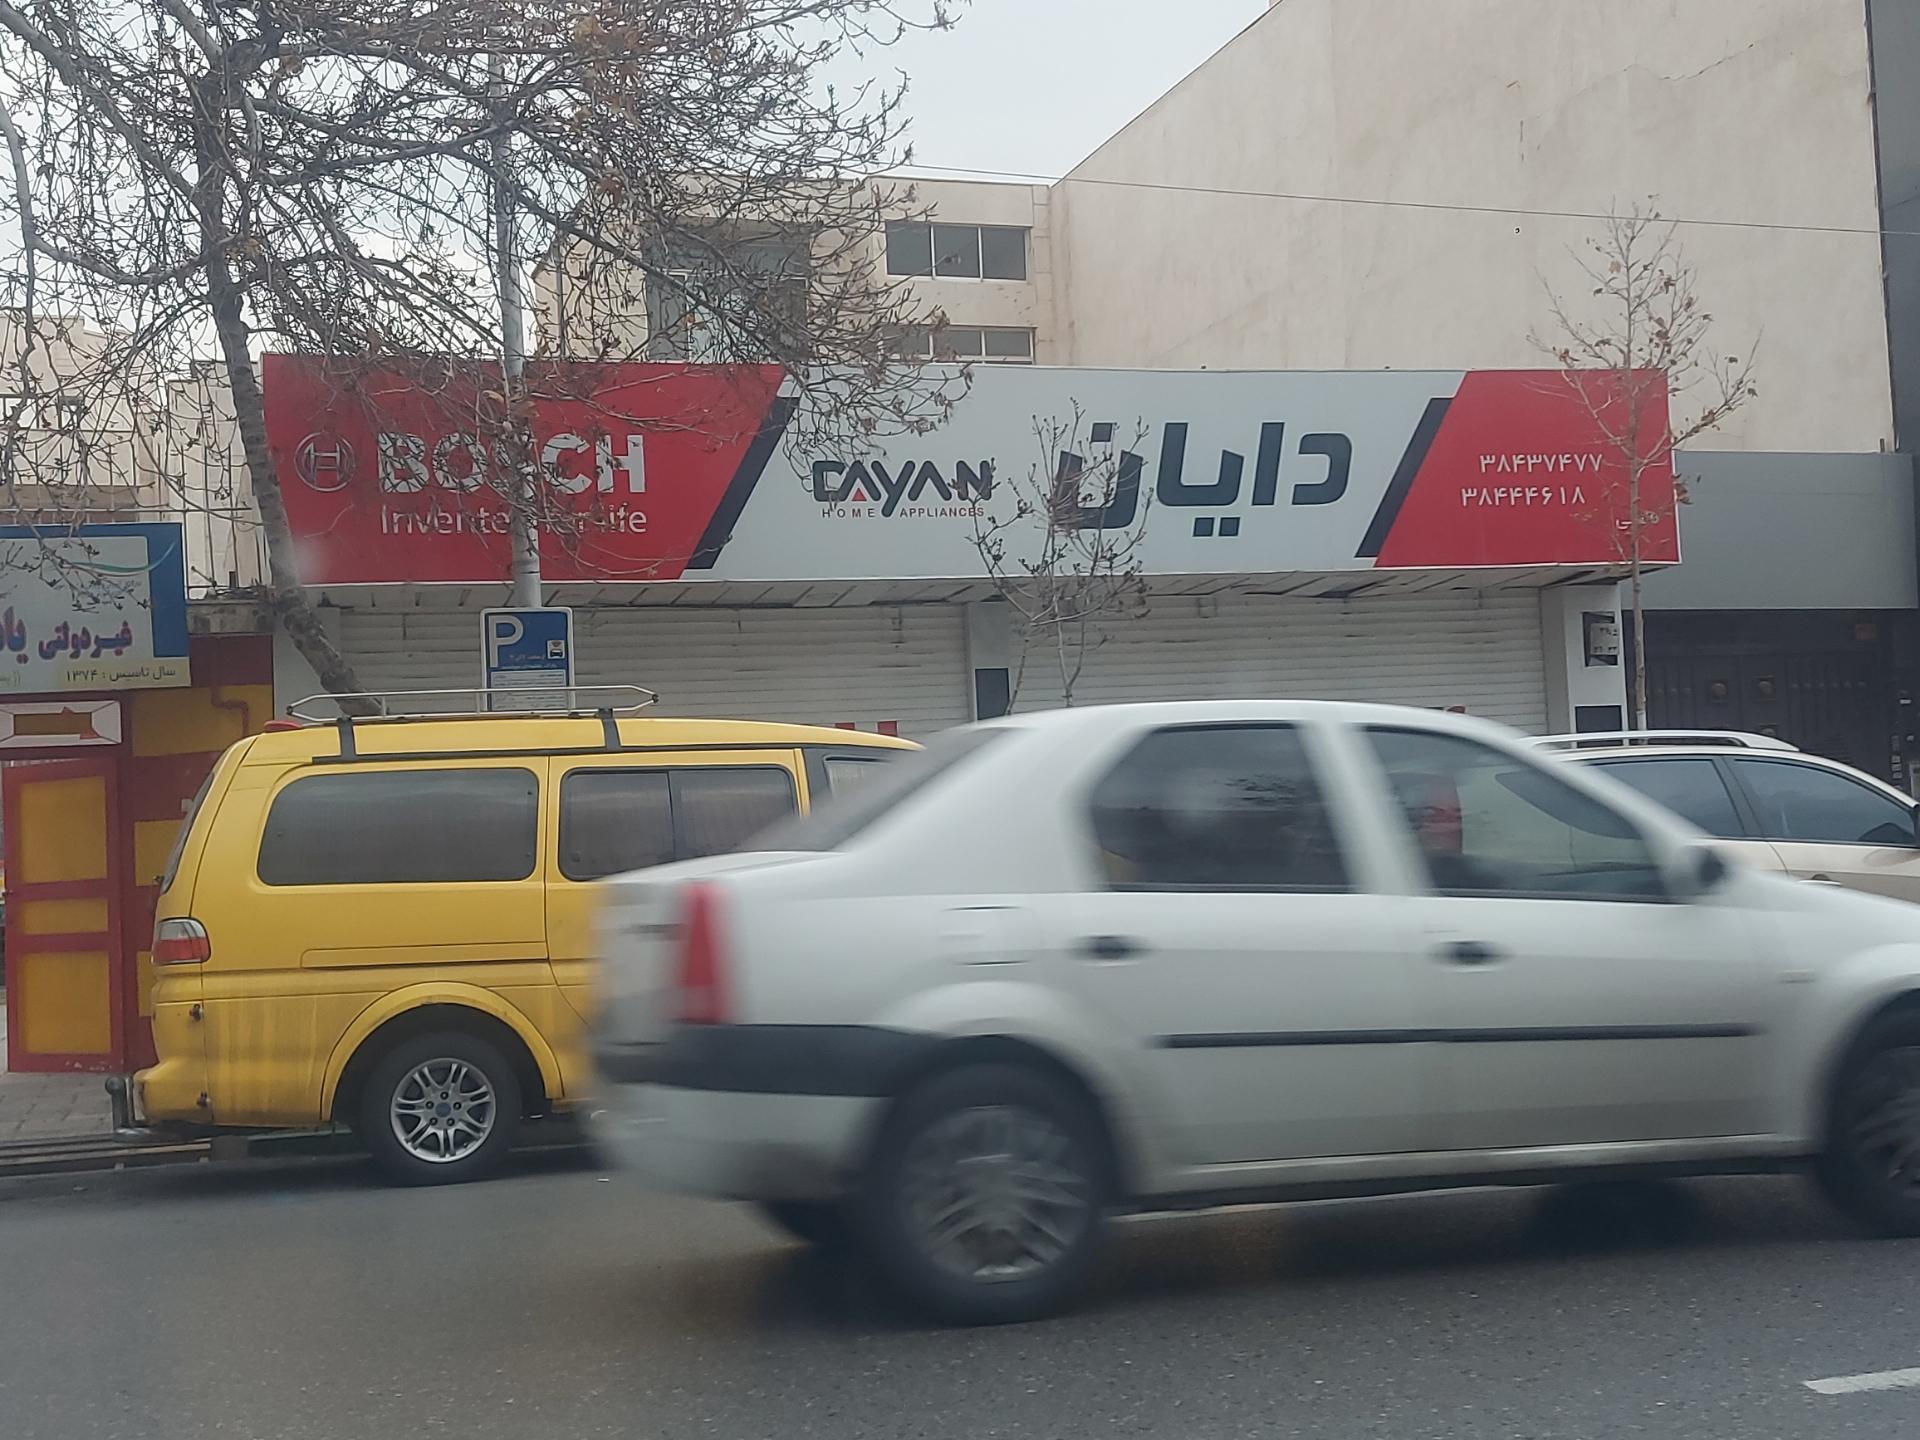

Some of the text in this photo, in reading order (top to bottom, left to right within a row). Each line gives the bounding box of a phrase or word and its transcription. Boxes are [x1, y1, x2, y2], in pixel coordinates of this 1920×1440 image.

[1479, 453, 1603, 474] ۳۸۴۳۷۴۷۷
[1055, 421, 1353, 538] دایان
[1460, 485, 1586, 508] ۳۸۴۴۴۶۱۸
[381, 504, 520, 535] Invente
[821, 506, 985, 519] HOME APPLIANCES
[488, 614, 524, 668] P
[65, 668, 99, 681] ۱۳۷۴
